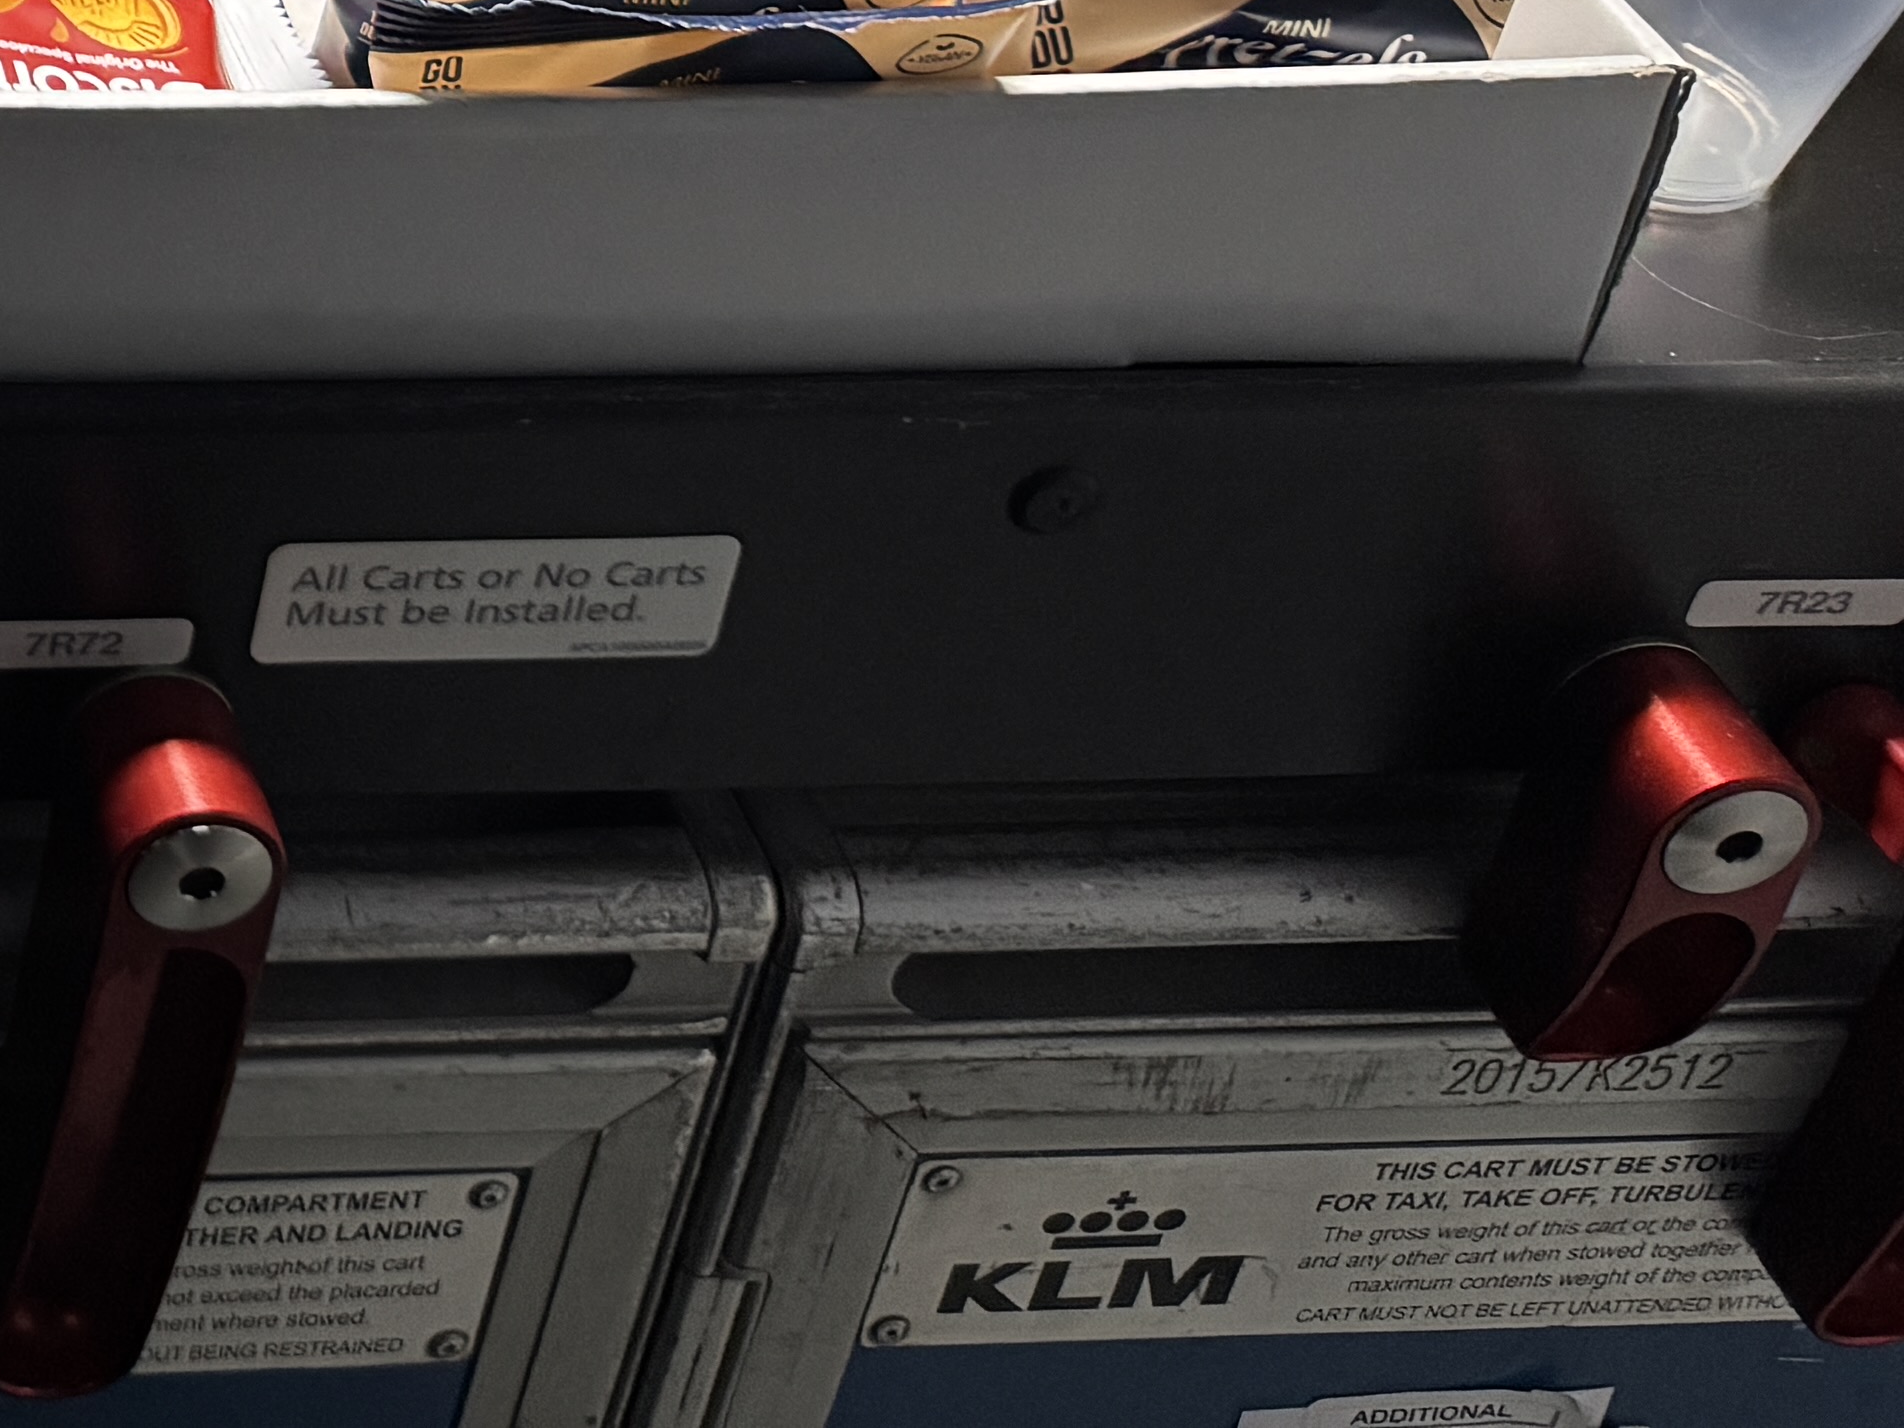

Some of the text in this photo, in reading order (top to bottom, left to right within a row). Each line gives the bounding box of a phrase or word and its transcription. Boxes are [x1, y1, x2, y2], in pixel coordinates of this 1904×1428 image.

[1262, 17, 1333, 39] MINI
[421, 55, 463, 85] GO
[293, 560, 707, 593] All Carts or No Carts
[285, 593, 646, 628] Must be Installed.
[1755, 590, 1854, 615] 7R23
[24, 629, 125, 659] 7R72
[1376, 1155, 1657, 1181] THIS CART MUST BE
[203, 1189, 429, 1216] COMPARTMENT
[1315, 1186, 1601, 1213] FOR TAXI, TAKE OFF,
[263, 1218, 465, 1244] AND LANDING
[1323, 1225, 1364, 1244] The
[1368, 1227, 1430, 1246] gross
[1437, 1221, 1510, 1243] weight
[1512, 1219, 1542, 1238] of
[1541, 1219, 1579, 1237] this
[1585, 1217, 1630, 1236] cart
[1661, 1215, 1698, 1232] the
[336, 1253, 427, 1275] this cart
[1297, 1240, 1740, 1271] and any other cart when stowed together
[199, 1278, 442, 1305] exceed the placarded
[935, 1254, 1247, 1315] KLM
[1346, 1273, 1453, 1293] maximum
[1458, 1271, 1552, 1290] contents
[1558, 1268, 1630, 1289] weight
[1633, 1266, 1664, 1285] of
[1667, 1266, 1697, 1283] the
[210, 1314, 280, 1331] where
[1295, 1295, 1714, 1324] CART MUST NOT BE LEFT UNATTENDED
[187, 1337, 405, 1361] BEING RESTRAINED
[1350, 1402, 1513, 1428] ADDITIONAL
